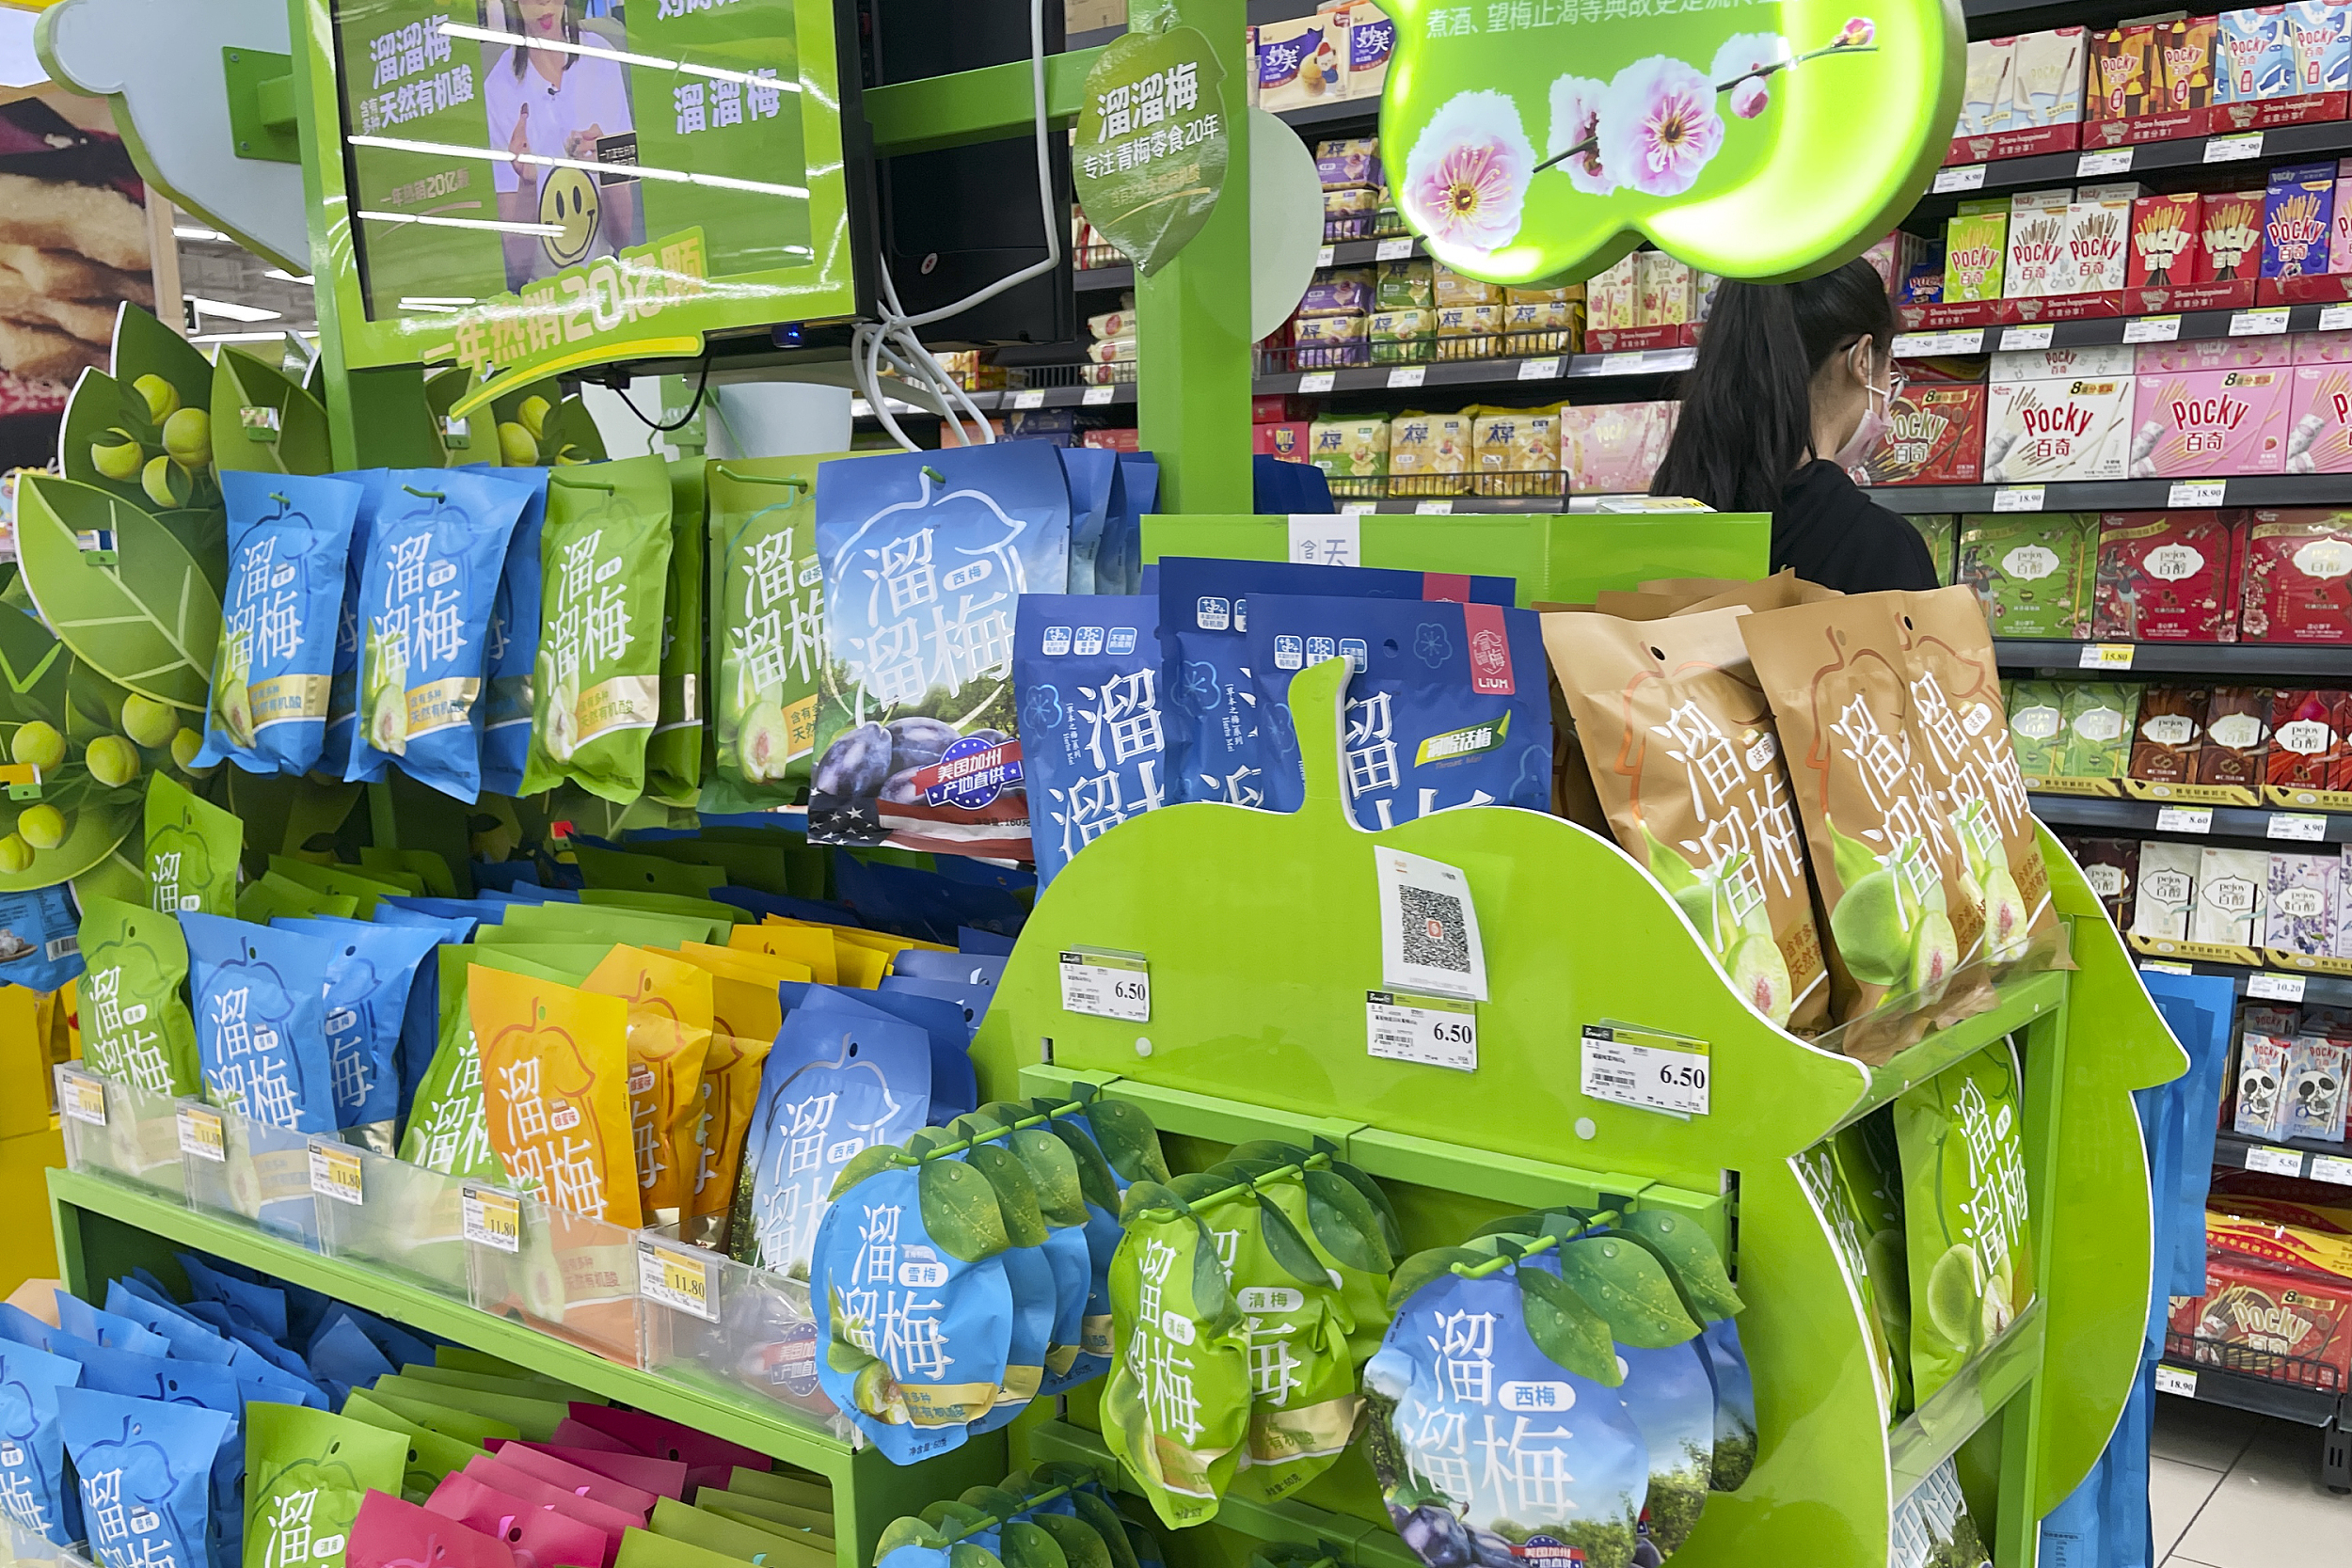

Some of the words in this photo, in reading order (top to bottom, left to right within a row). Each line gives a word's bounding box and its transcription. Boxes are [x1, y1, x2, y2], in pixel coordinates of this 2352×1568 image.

[369, 13, 453, 89] 溜溜梅
[379, 63, 474, 130] 天然有机酸
[674, 68, 781, 135] 溜溜梅
[1096, 61, 1200, 144] 溜溜梅
[1083, 113, 1220, 180] 专注青梅零食20年
[2134, 225, 2192, 256] POCKY
[2202, 224, 2261, 256] POCKY
[2266, 218, 2327, 247] POCKY
[1951, 246, 2000, 271] POCKY
[2012, 242, 2063, 265] POCKY
[2070, 235, 2122, 262] POCKY
[2278, 244, 2309, 262] 百奇
[1960, 268, 1984, 285] 百奇
[2022, 265, 2046, 280] 百奇
[2079, 261, 2105, 277] 百奇
[2023, 402, 2093, 437] POCKY
[2171, 394, 2249, 430] POCKY
[2037, 438, 2071, 457] 百奇
[2186, 432, 2223, 451] 百奇
[1894, 443, 1929, 464] 百奇
[2018, 495, 2042, 504] 18.90
[2197, 489, 2221, 499] 18.90
[952, 564, 983, 585] 西梅
[2104, 653, 2128, 662] 15.80
[1077, 667, 1166, 771] 溜
[937, 748, 1004, 783] 美国加州
[943, 765, 1007, 802] 产地直供
[2303, 823, 2324, 832] 8.90
[1115, 981, 1146, 1001] 6.50
[2276, 983, 2301, 993] 10.20
[1434, 1022, 1472, 1044] 6.50
[1660, 1064, 1705, 1089] 6.50
[336, 1169, 361, 1190] 11.80
[489, 1218, 516, 1238] 11.80
[908, 1266, 936, 1282] 雪梅
[674, 1273, 705, 1298] 11.80
[1248, 1291, 1289, 1309] 清梅
[2233, 1301, 2313, 1345] POCKY
[1427, 1308, 1497, 1409] 溜
[2169, 1379, 2193, 1392] 18.90
[1514, 1386, 1557, 1408] 西梅
[264, 1487, 313, 1568] 溜
